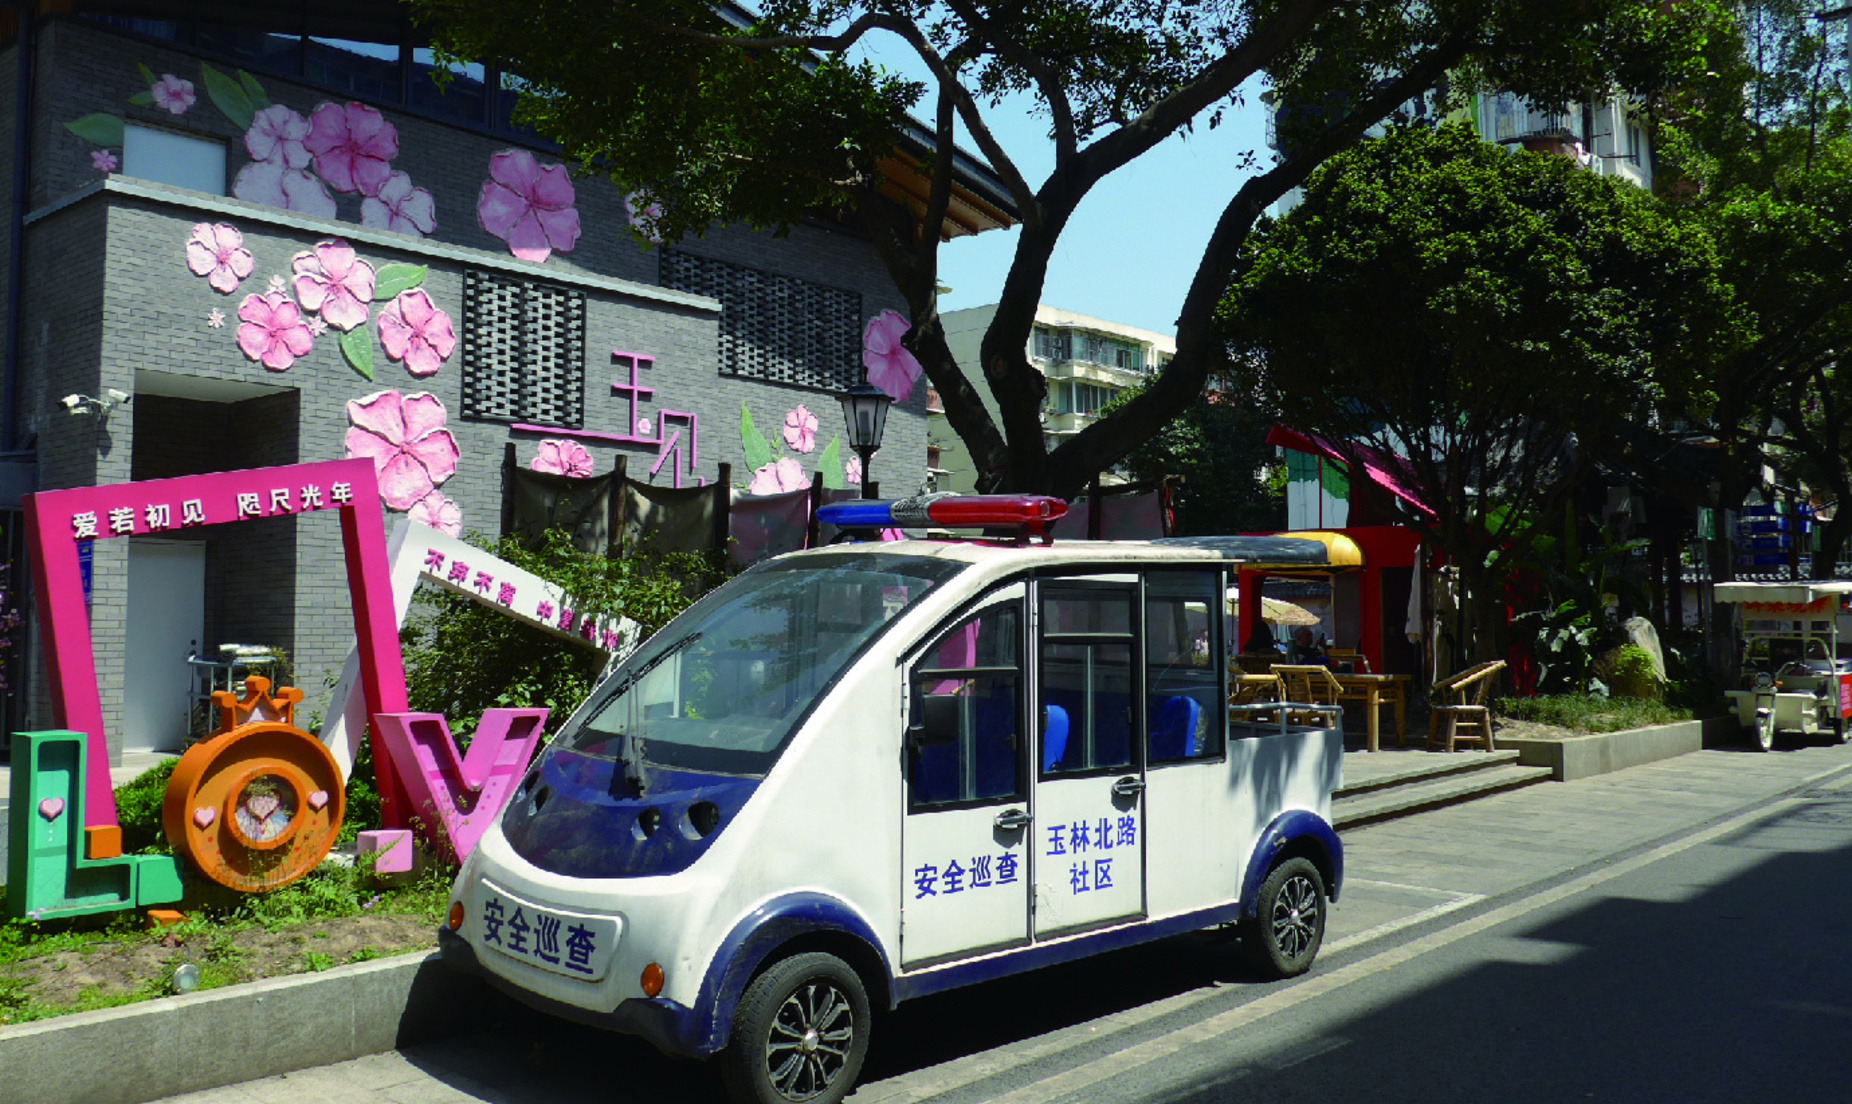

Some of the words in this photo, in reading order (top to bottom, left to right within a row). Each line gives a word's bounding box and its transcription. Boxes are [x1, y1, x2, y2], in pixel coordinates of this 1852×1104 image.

[72, 498, 206, 539] 爱若初见
[236, 481, 354, 517] 咫尺光年
[424, 548, 517, 608] 不弃不离
[1046, 815, 1137, 856] 玉林北路
[914, 851, 1018, 900] 安全巡查
[1069, 858, 1114, 895] 社区
[483, 897, 596, 975] 安全巡查
